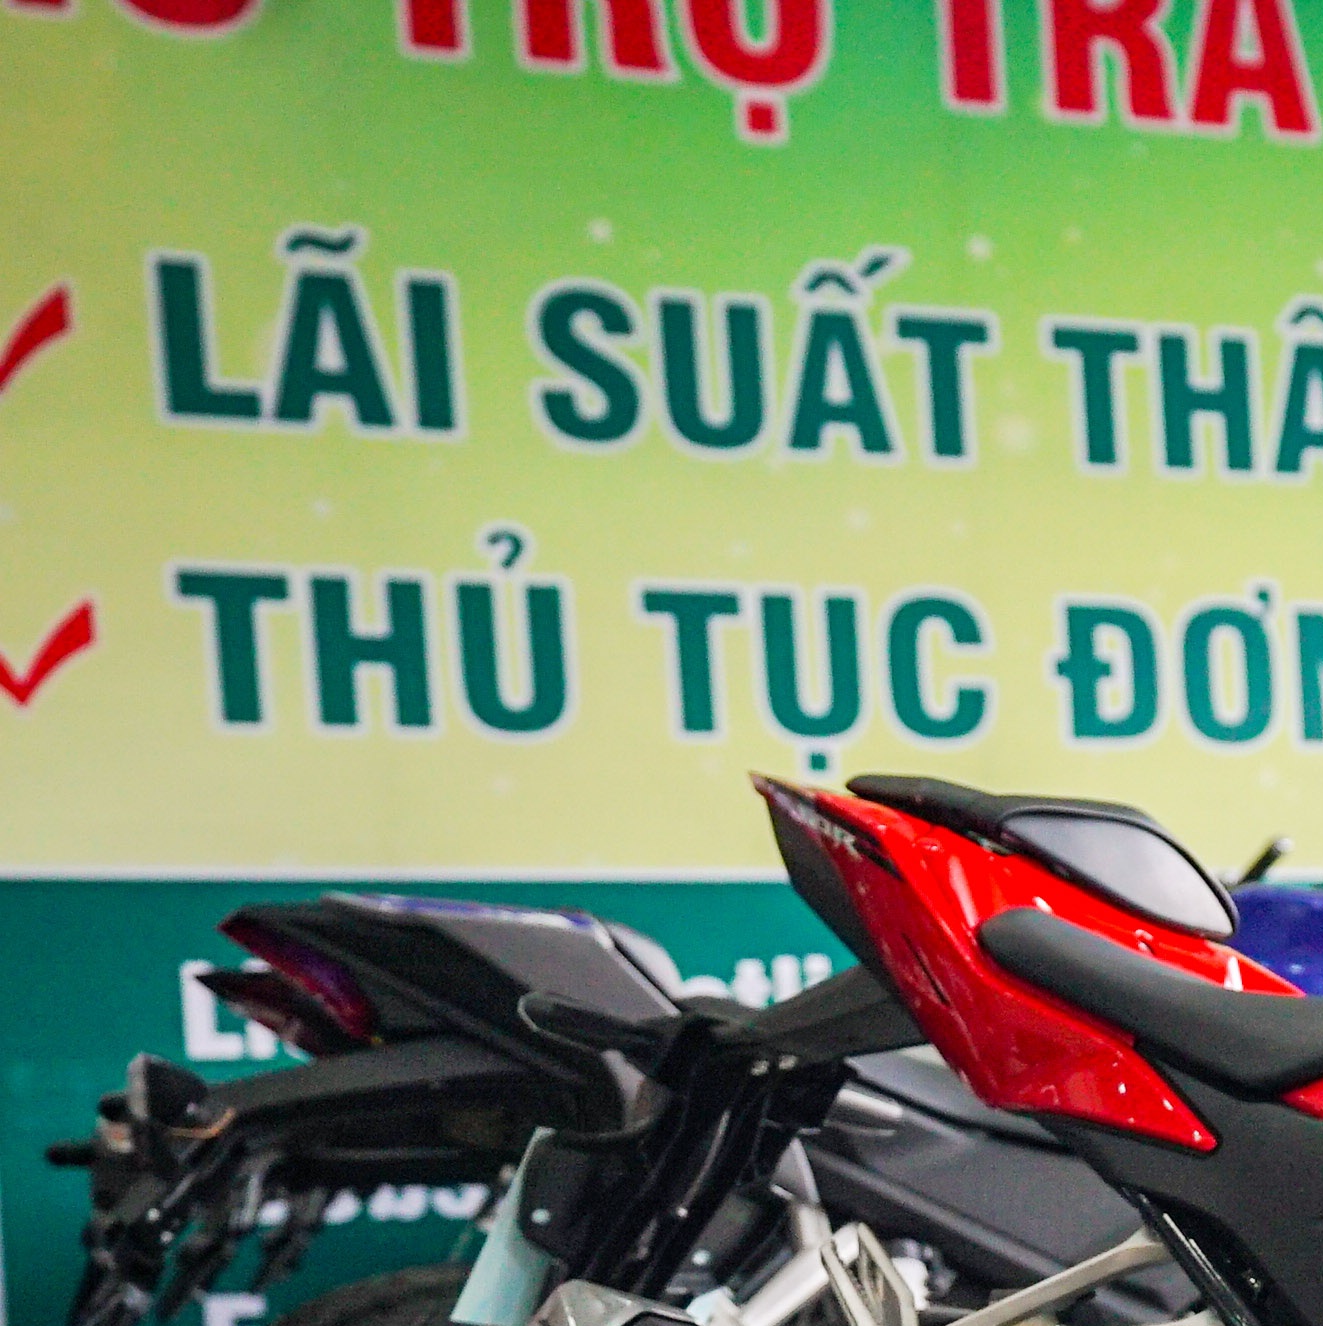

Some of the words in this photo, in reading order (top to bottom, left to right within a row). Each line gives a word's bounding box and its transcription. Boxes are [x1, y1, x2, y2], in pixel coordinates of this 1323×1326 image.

[157, 231, 456, 430] LÃI
[540, 254, 988, 458] SUẤT
[177, 532, 567, 732] THỦ
[642, 590, 986, 771] TỤC
